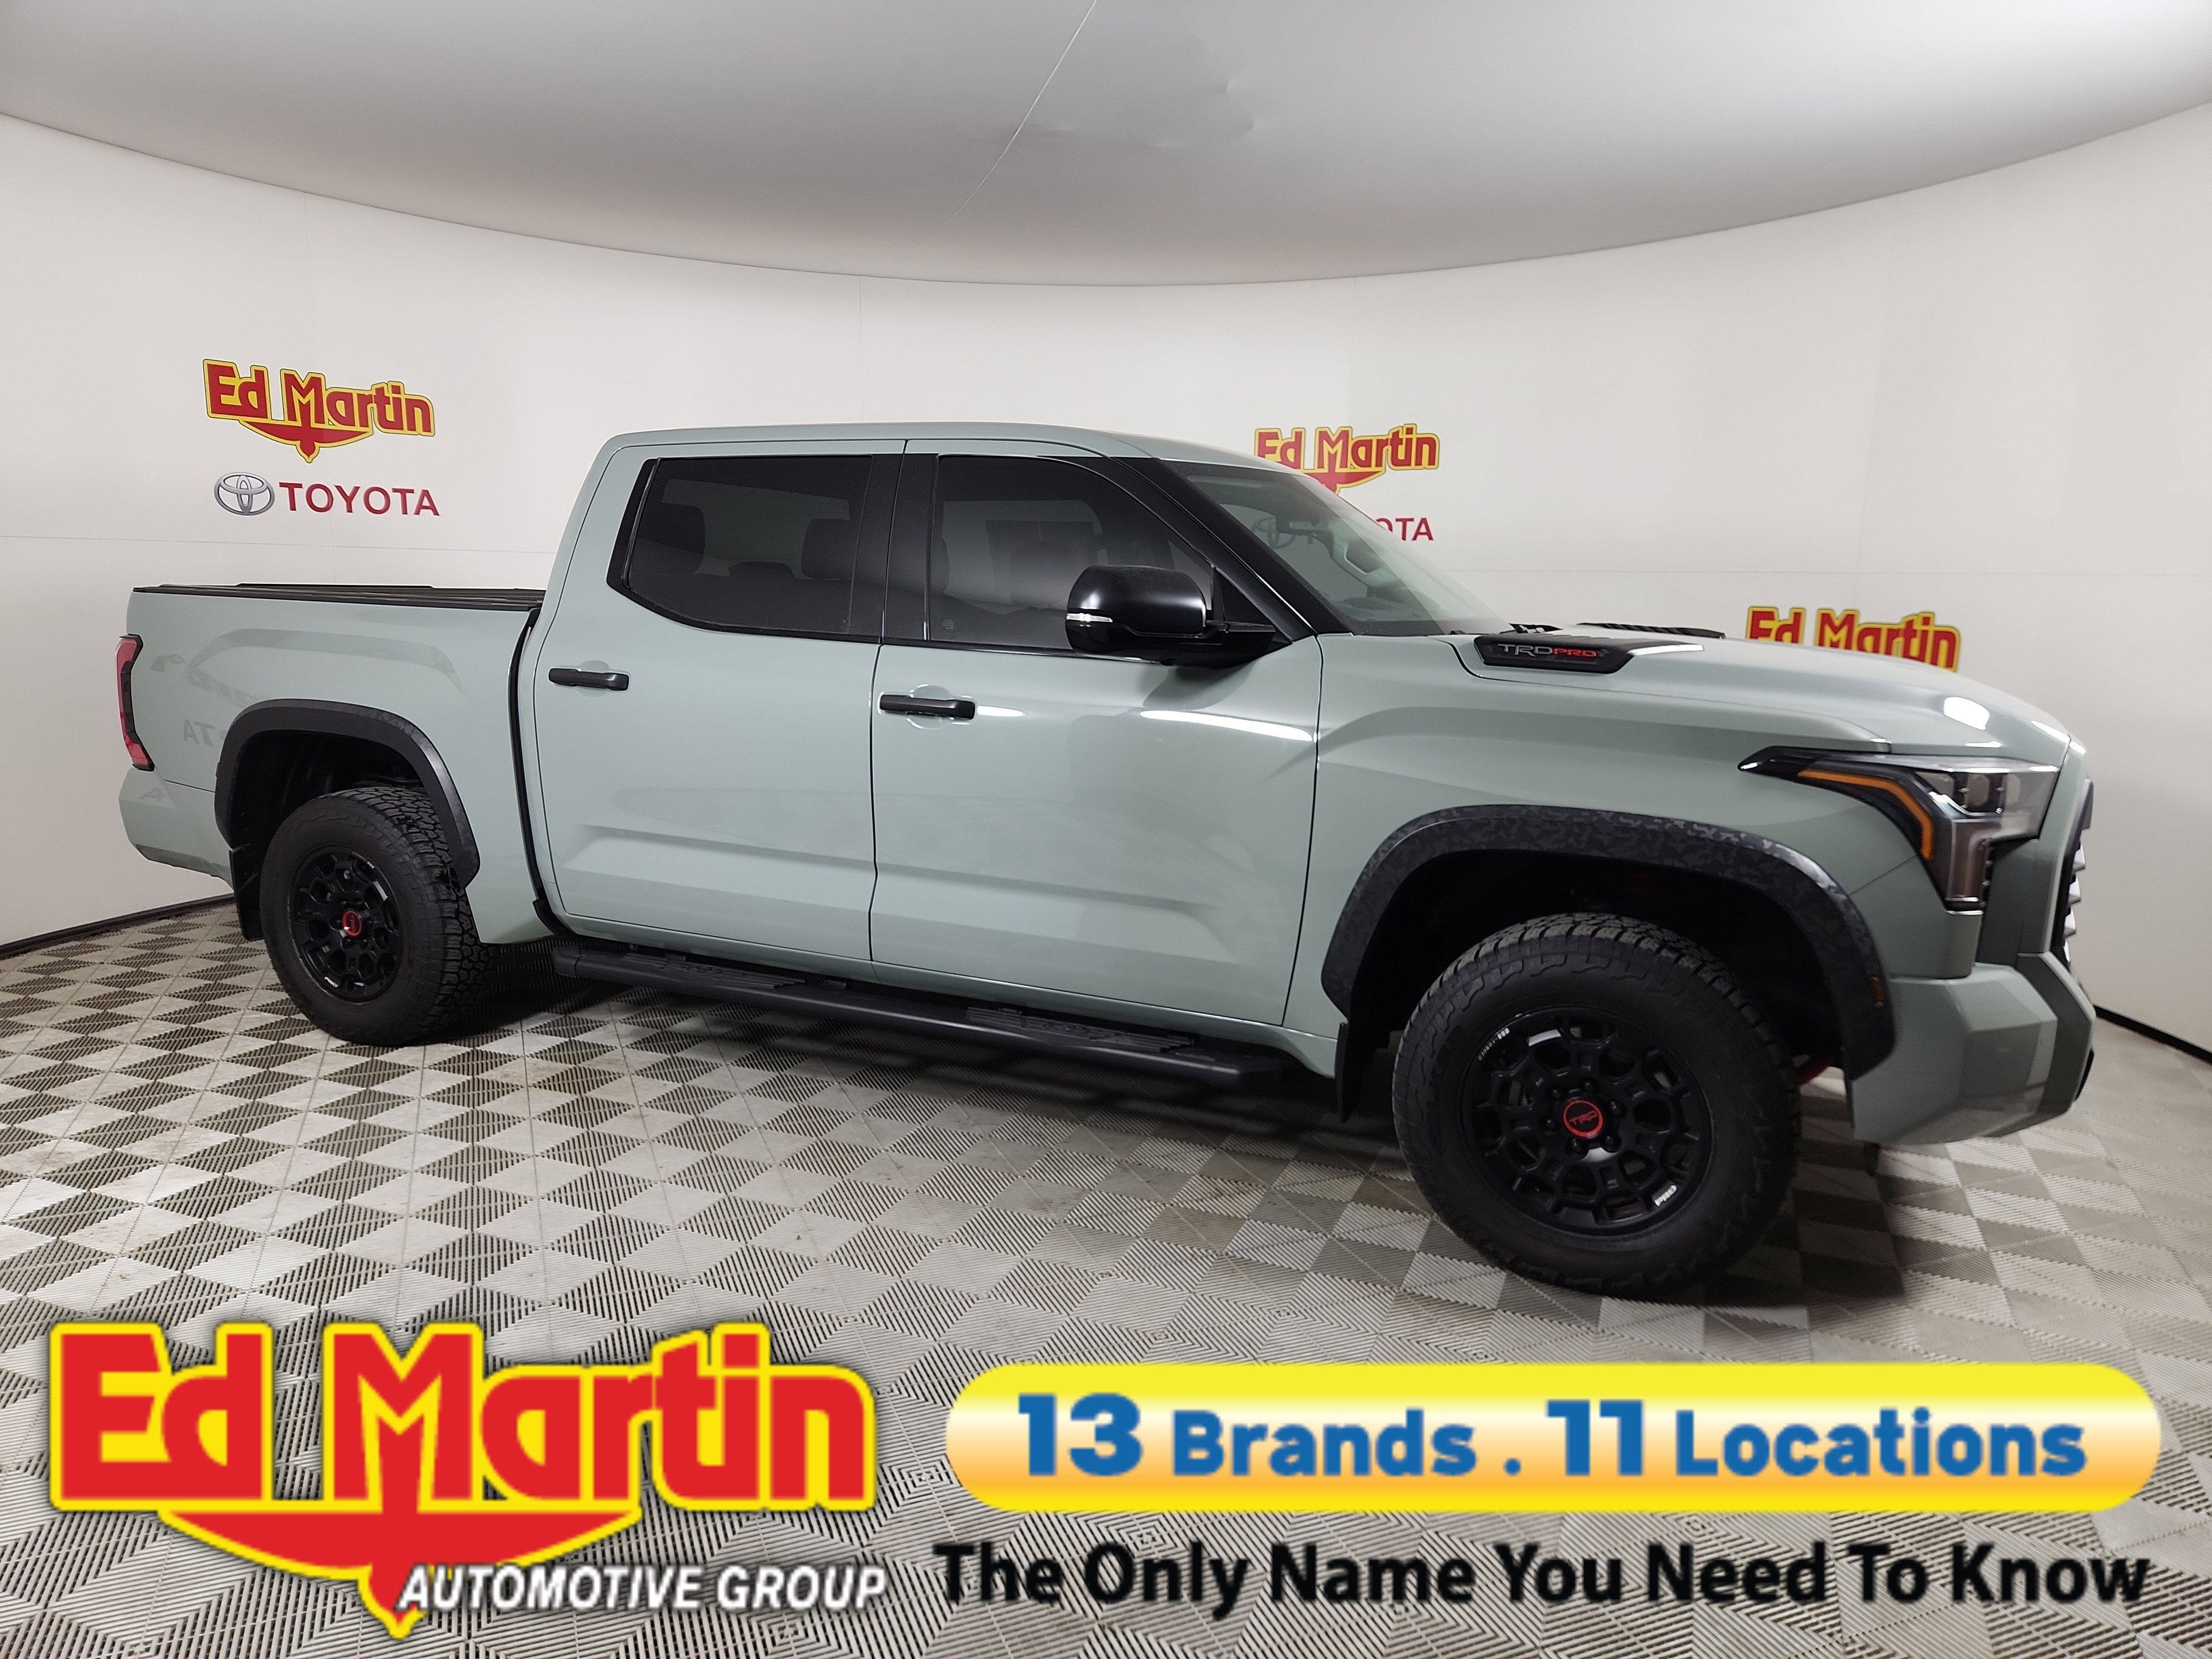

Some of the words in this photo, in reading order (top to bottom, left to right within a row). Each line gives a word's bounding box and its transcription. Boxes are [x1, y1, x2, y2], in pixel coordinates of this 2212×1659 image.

[205, 362, 269, 419] Ed
[282, 371, 433, 434] Martin
[1256, 430, 1303, 470] Ed
[1316, 426, 1438, 469] Martin
[279, 481, 440, 516] TOYOTA
[1748, 609, 1802, 644] Ed
[1817, 612, 1957, 670] Martin
